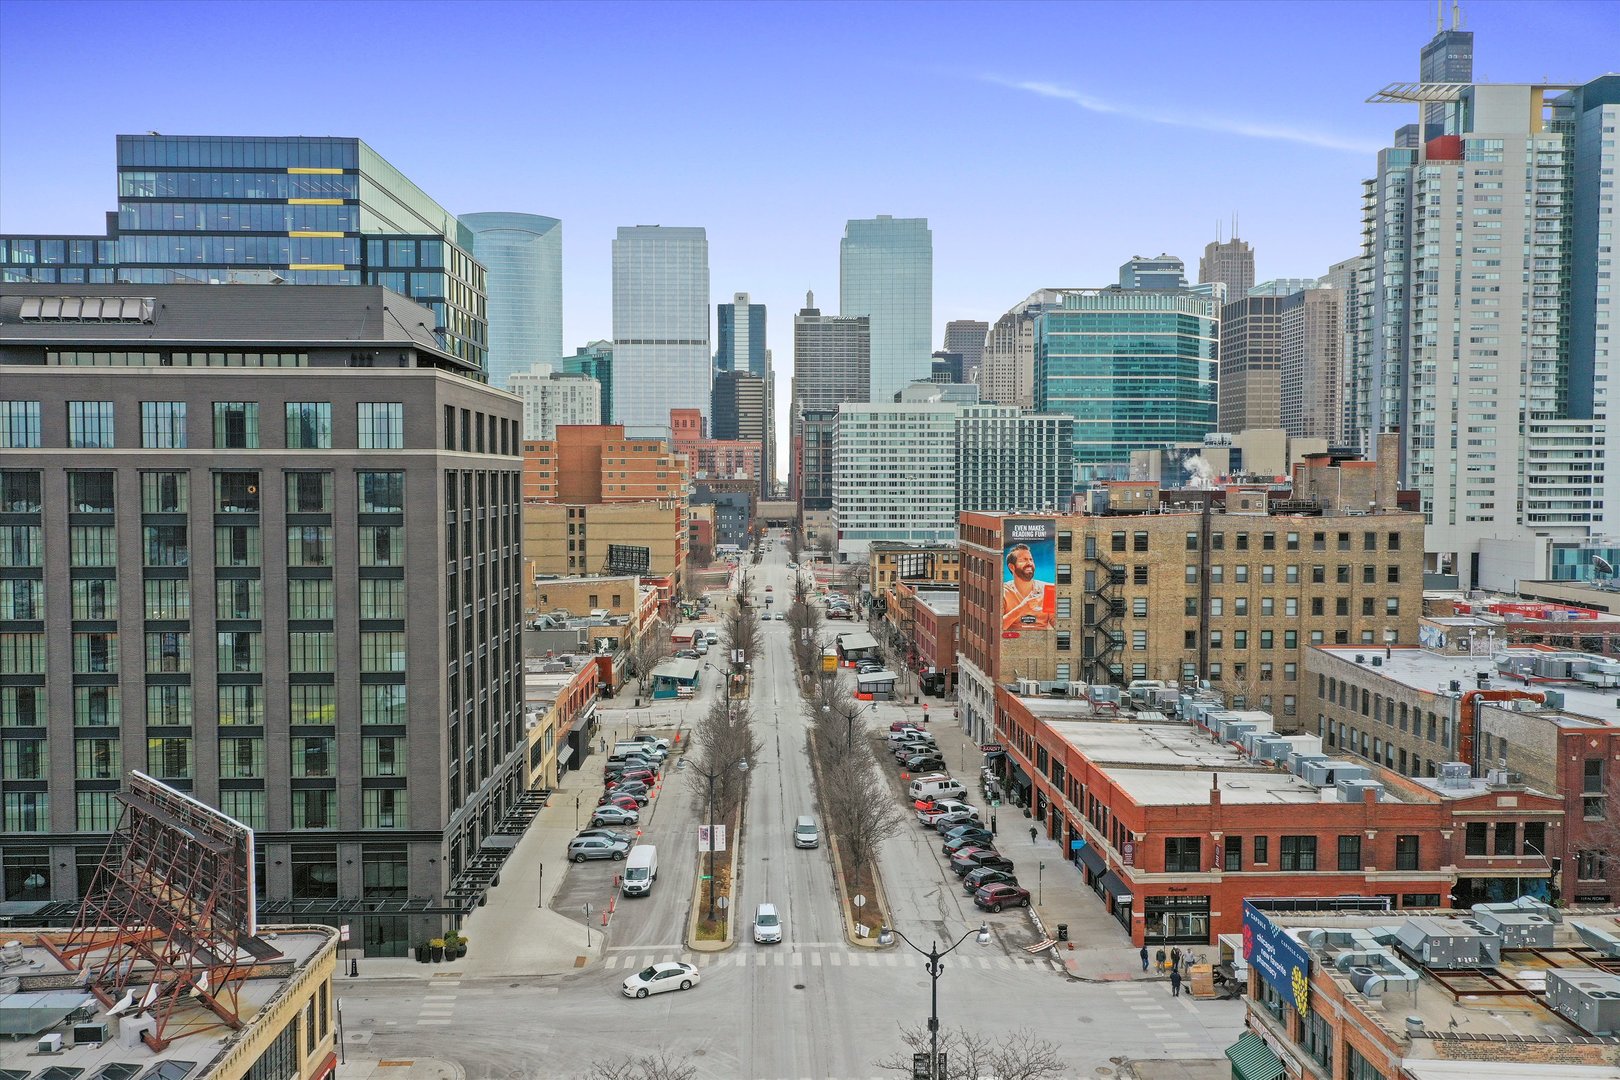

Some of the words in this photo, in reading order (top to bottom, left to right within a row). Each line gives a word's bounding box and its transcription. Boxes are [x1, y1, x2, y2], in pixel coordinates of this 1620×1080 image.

[1250, 913, 1266, 930] CAPSULE
[1256, 933, 1275, 955] chicago's
[1260, 948, 1270, 960] new
[1256, 954, 1277, 980] pharmacy
[1270, 955, 1287, 977] favorite
